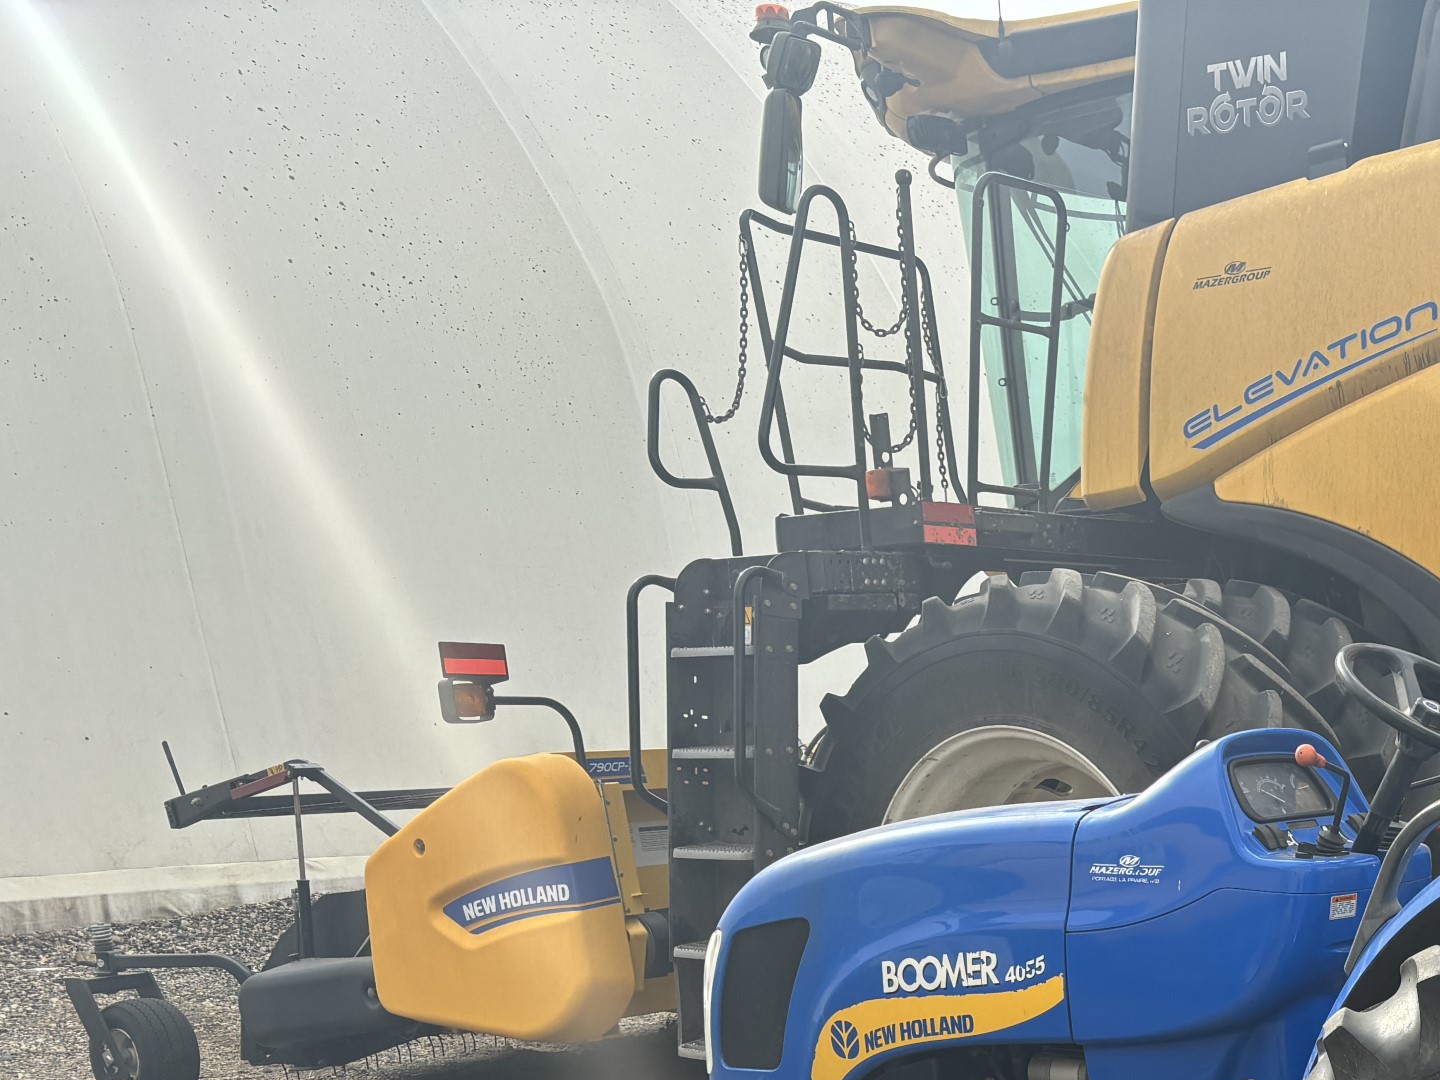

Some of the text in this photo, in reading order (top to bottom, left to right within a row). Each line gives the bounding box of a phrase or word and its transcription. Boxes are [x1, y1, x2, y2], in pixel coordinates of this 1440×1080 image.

[1207, 51, 1288, 90] TWIN
[1187, 85, 1310, 136] ROTOR
[1193, 270, 1271, 290] MAZERGROUP
[1183, 300, 1438, 441] ELEVATION
[589, 761, 632, 773] 790CP-
[462, 884, 570, 921] NEW HOLLAND
[881, 950, 1046, 993] BOOMER 4055
[863, 1013, 974, 1053] NEW HOLLAND
